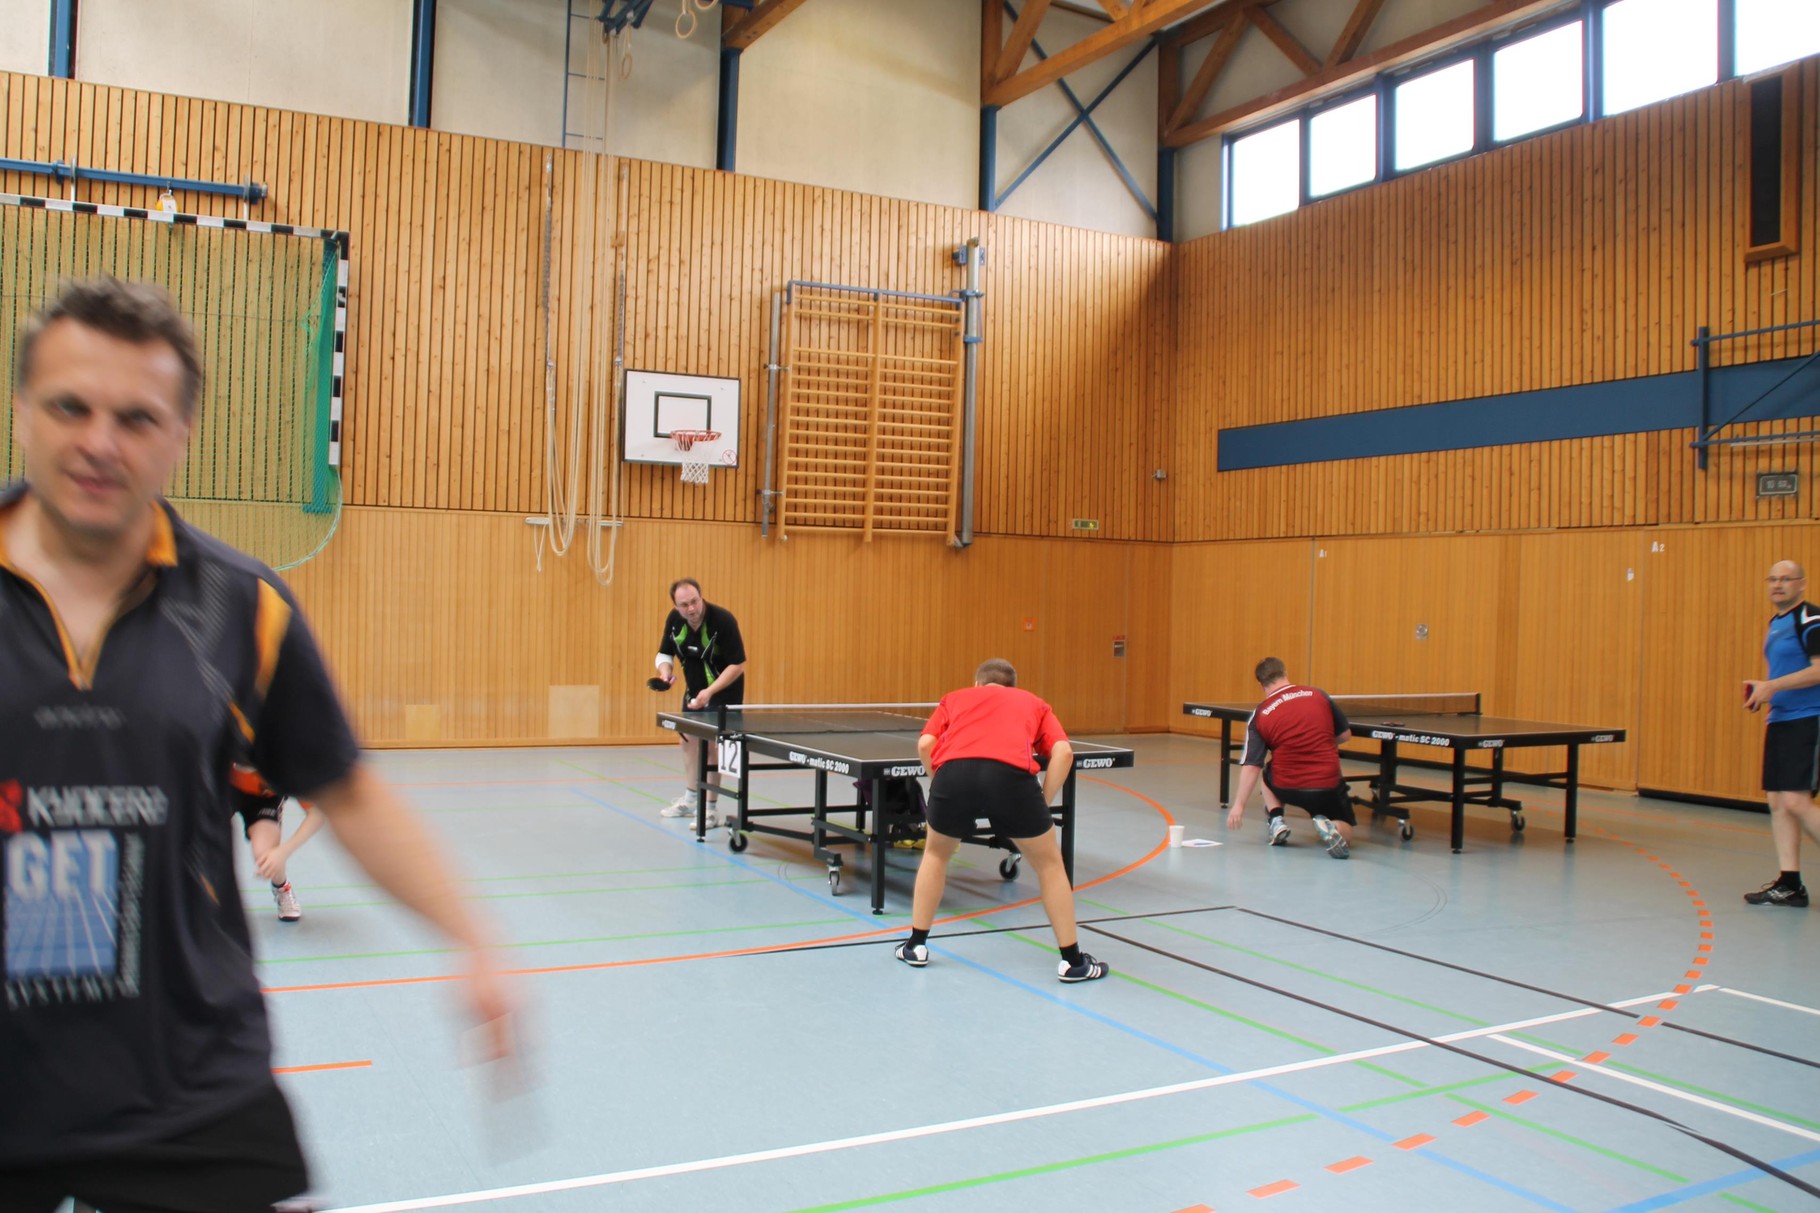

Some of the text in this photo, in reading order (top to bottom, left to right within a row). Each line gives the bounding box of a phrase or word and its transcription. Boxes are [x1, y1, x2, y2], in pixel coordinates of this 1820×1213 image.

[1262, 690, 1313, 715] Bayern München
[1420, 735, 1430, 744] SC
[1431, 737, 1450, 746] 2000
[720, 740, 737, 773] 12
[1083, 758, 1113, 768] GEWO
[825, 759, 835, 771] SC
[834, 761, 849, 774] 2000
[891, 765, 926, 777] GEWO
[7, 829, 118, 901] GET
